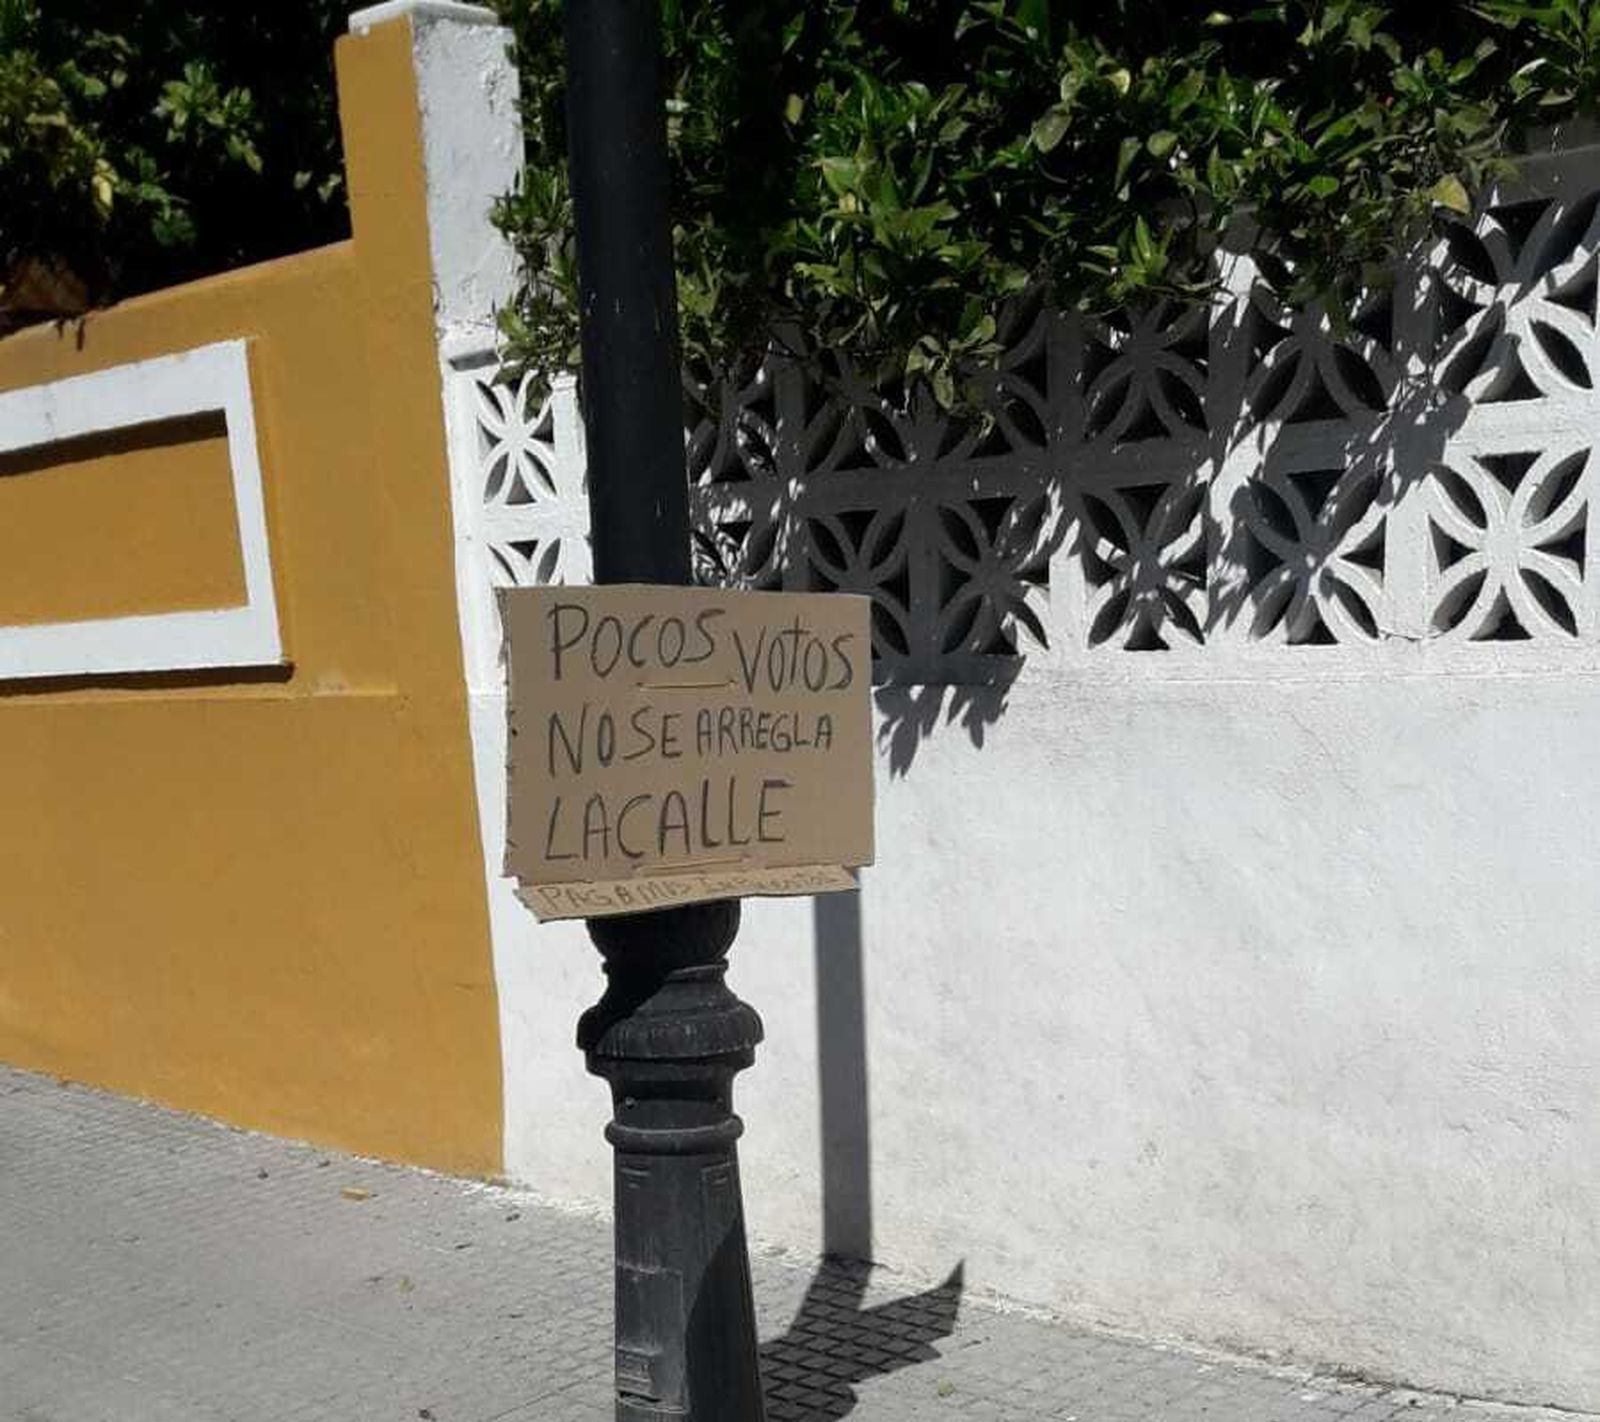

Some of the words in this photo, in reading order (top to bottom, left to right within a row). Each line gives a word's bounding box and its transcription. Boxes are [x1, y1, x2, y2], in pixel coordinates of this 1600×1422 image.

[546, 602, 726, 681] POCOS
[732, 614, 855, 695] VOTOS
[698, 704, 833, 755] ARREGLA
